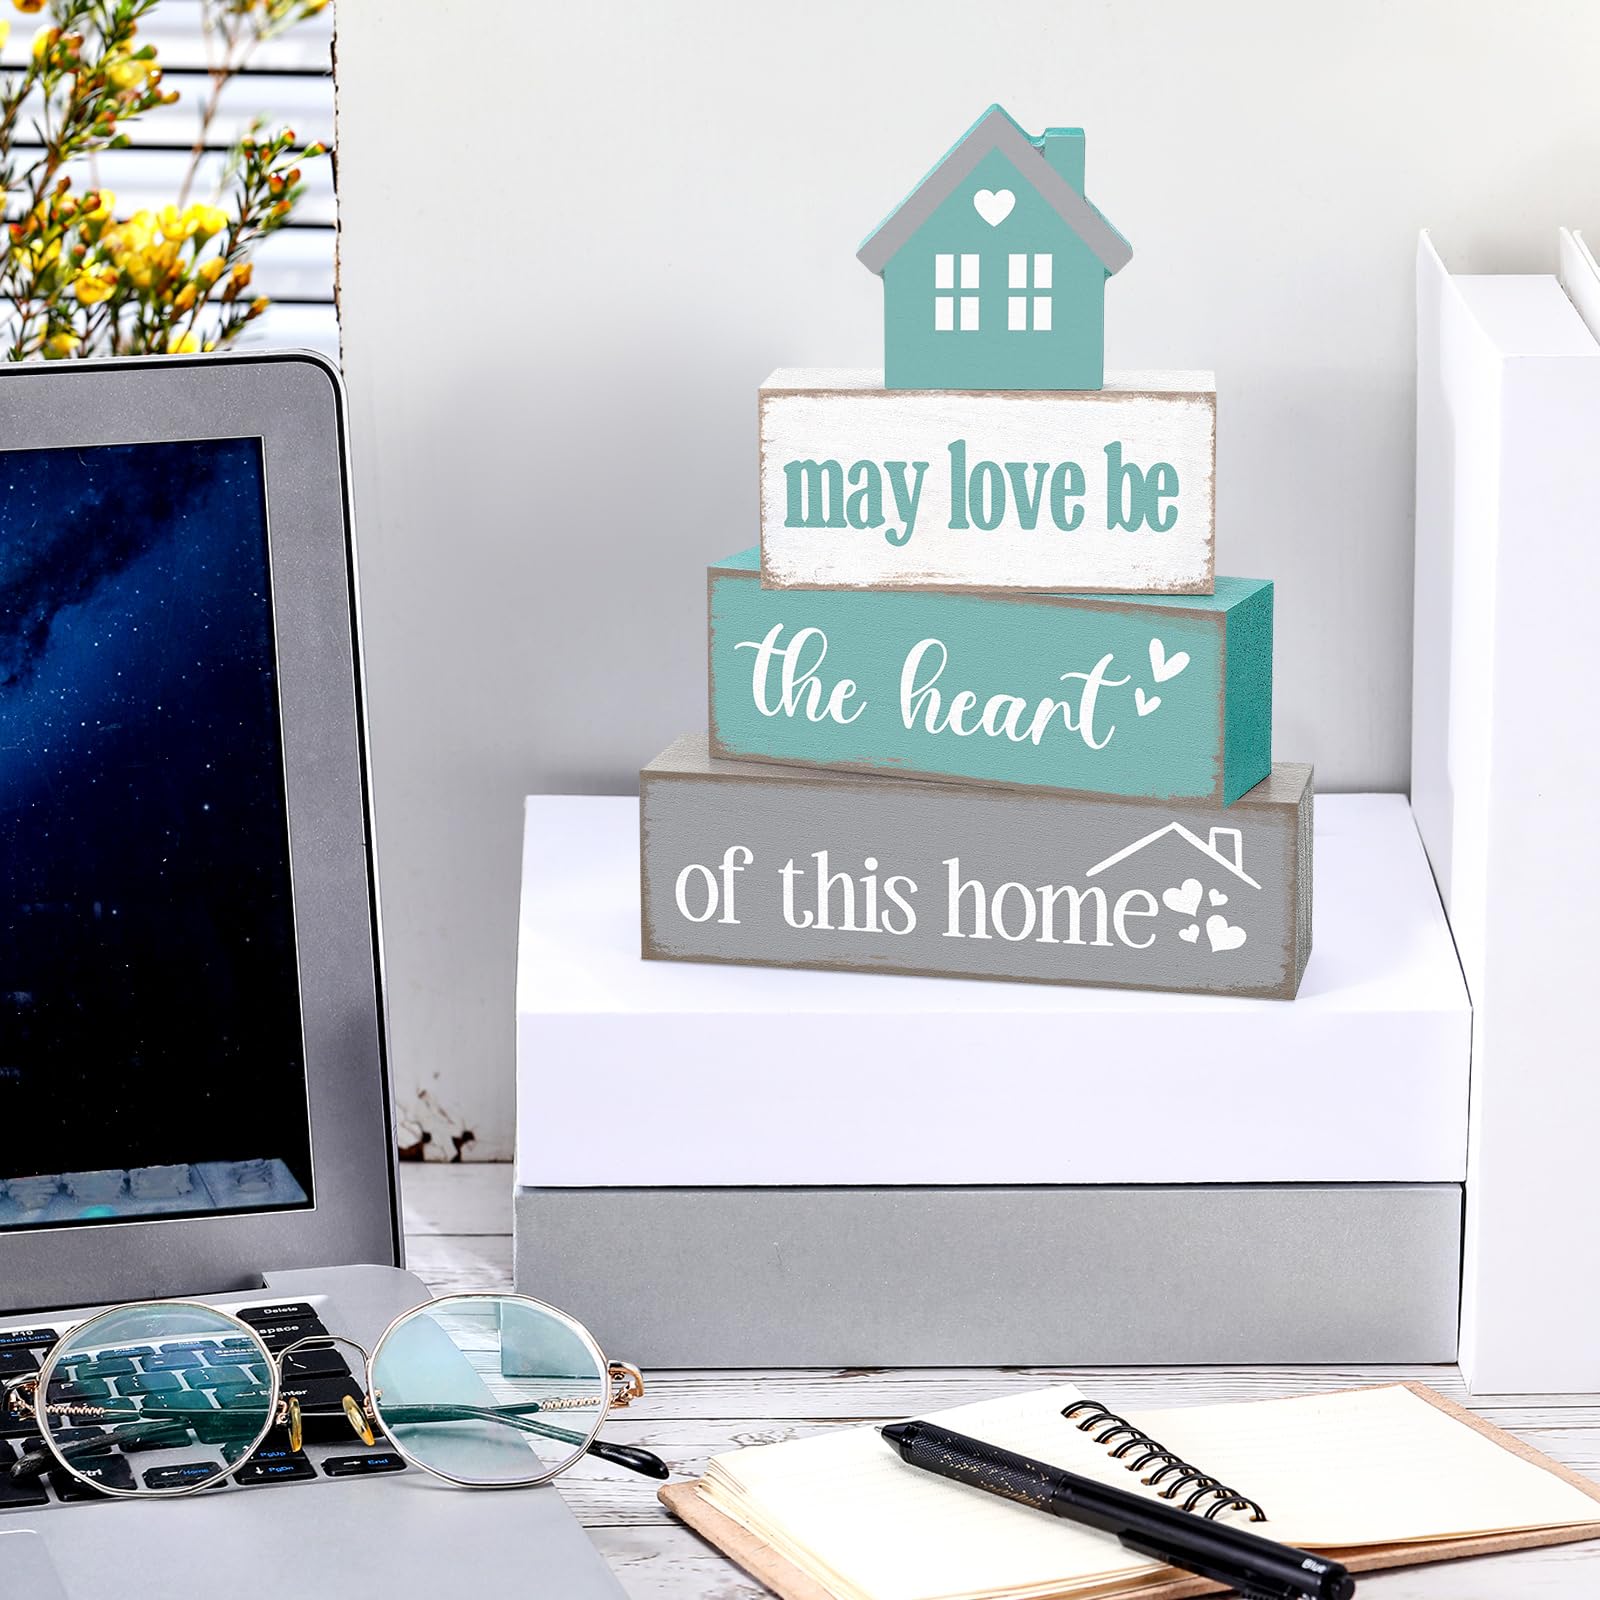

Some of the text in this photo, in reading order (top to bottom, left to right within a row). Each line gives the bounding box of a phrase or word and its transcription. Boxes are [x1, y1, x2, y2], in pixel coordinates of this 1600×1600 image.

[784, 440, 1179, 547] may love be
[734, 623, 1131, 750] the heart
[675, 845, 1159, 949] of this home
[259, 1451, 287, 1459] PgUp
[268, 1465, 294, 1473] PgDn
